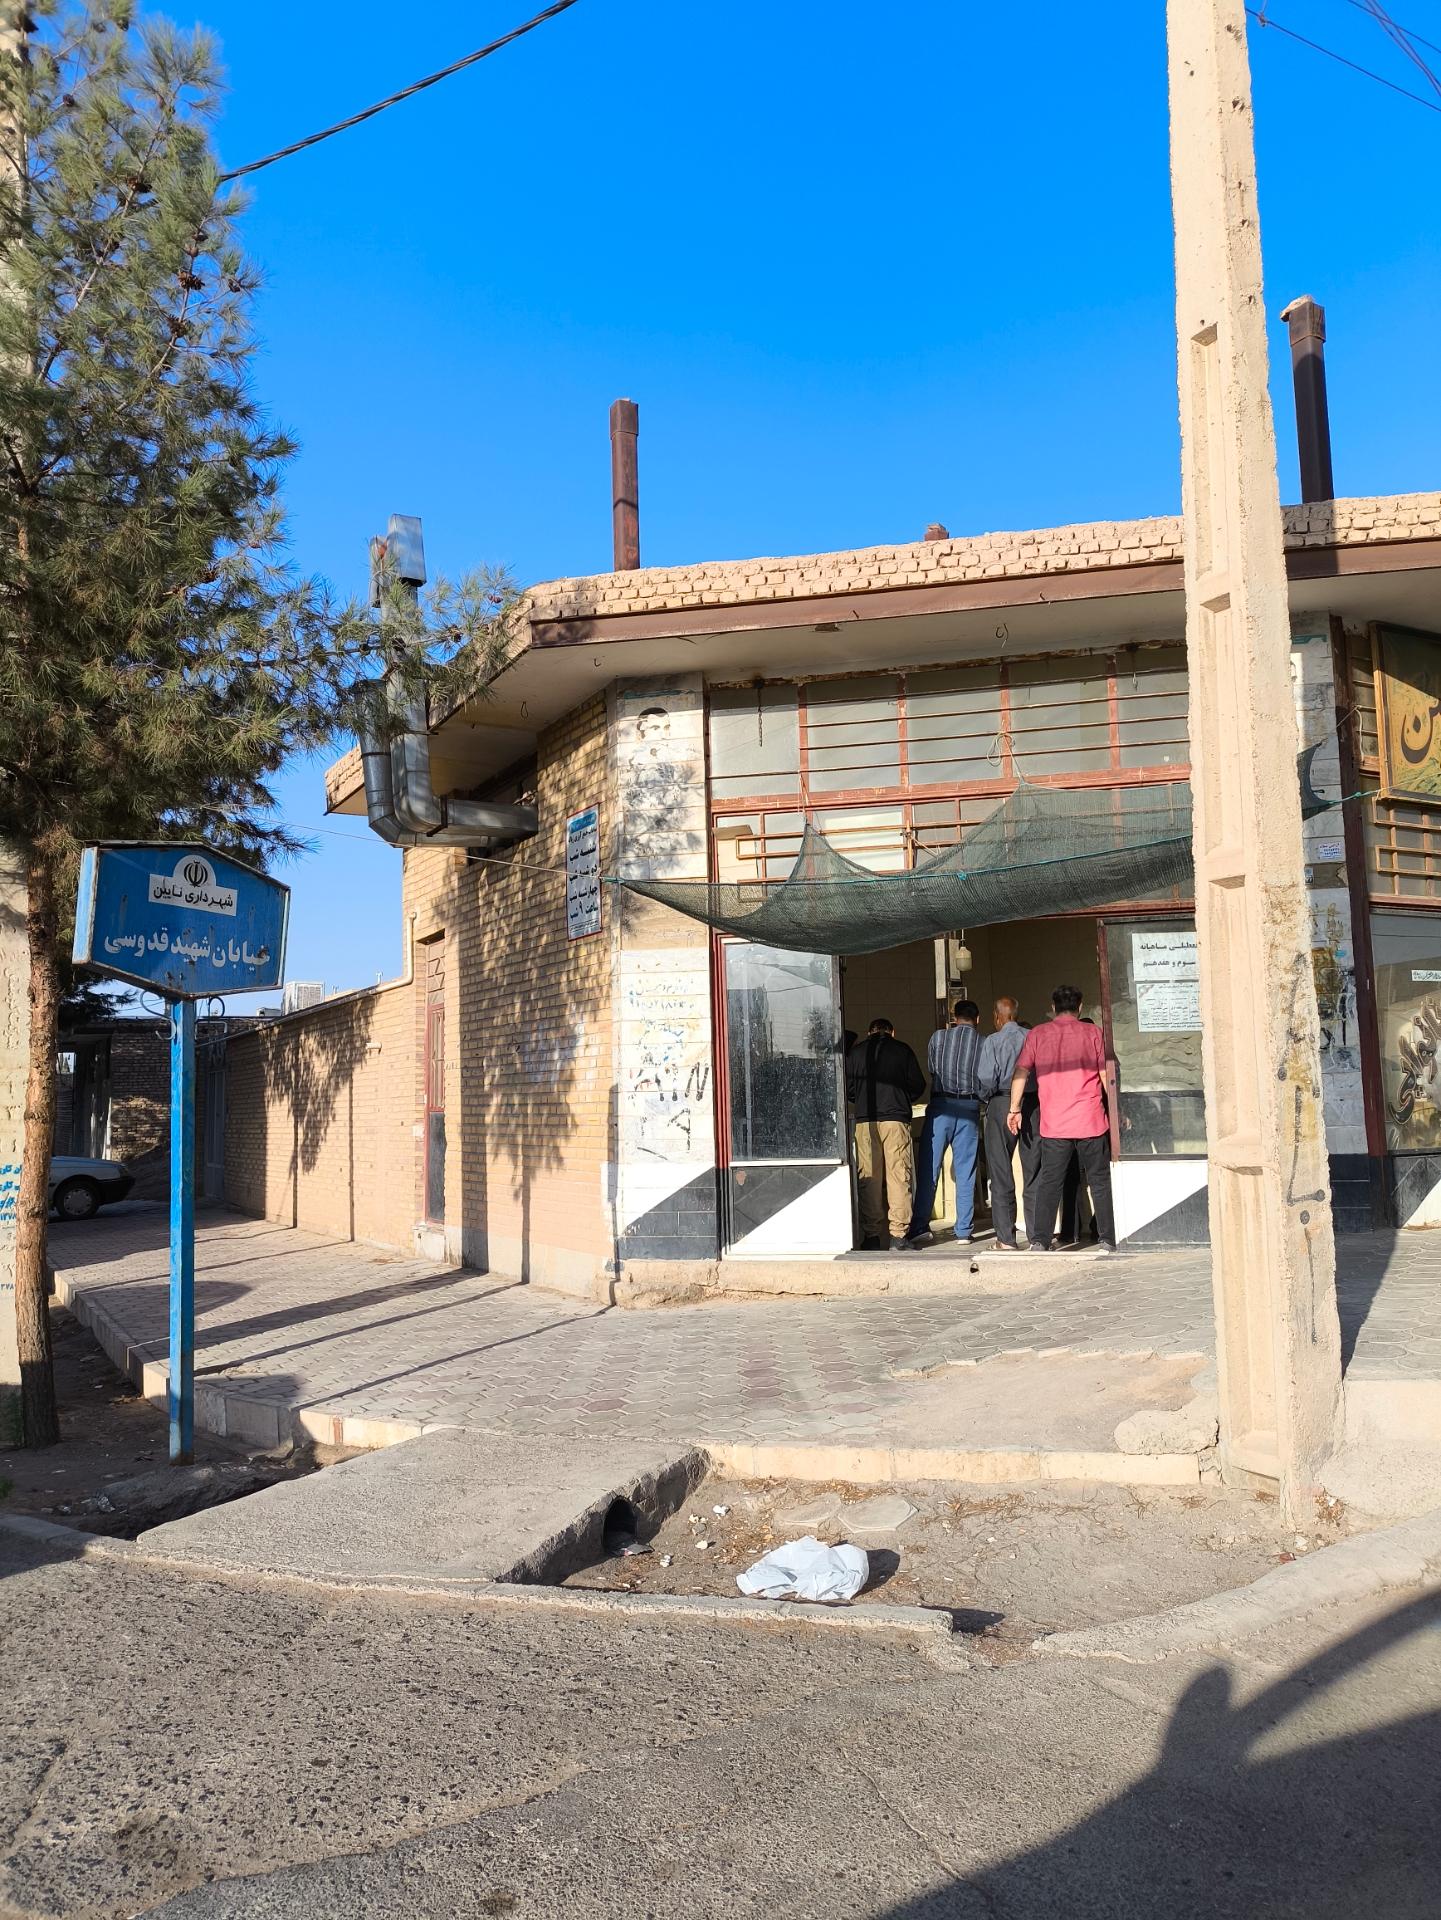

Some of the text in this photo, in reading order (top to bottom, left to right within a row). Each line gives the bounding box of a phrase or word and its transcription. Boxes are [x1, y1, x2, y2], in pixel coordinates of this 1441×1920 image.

[569, 841, 597, 864] شنبه شب
[184, 888, 234, 909] شهرداری
[104, 927, 271, 971] خیابان شهید قدوسی
